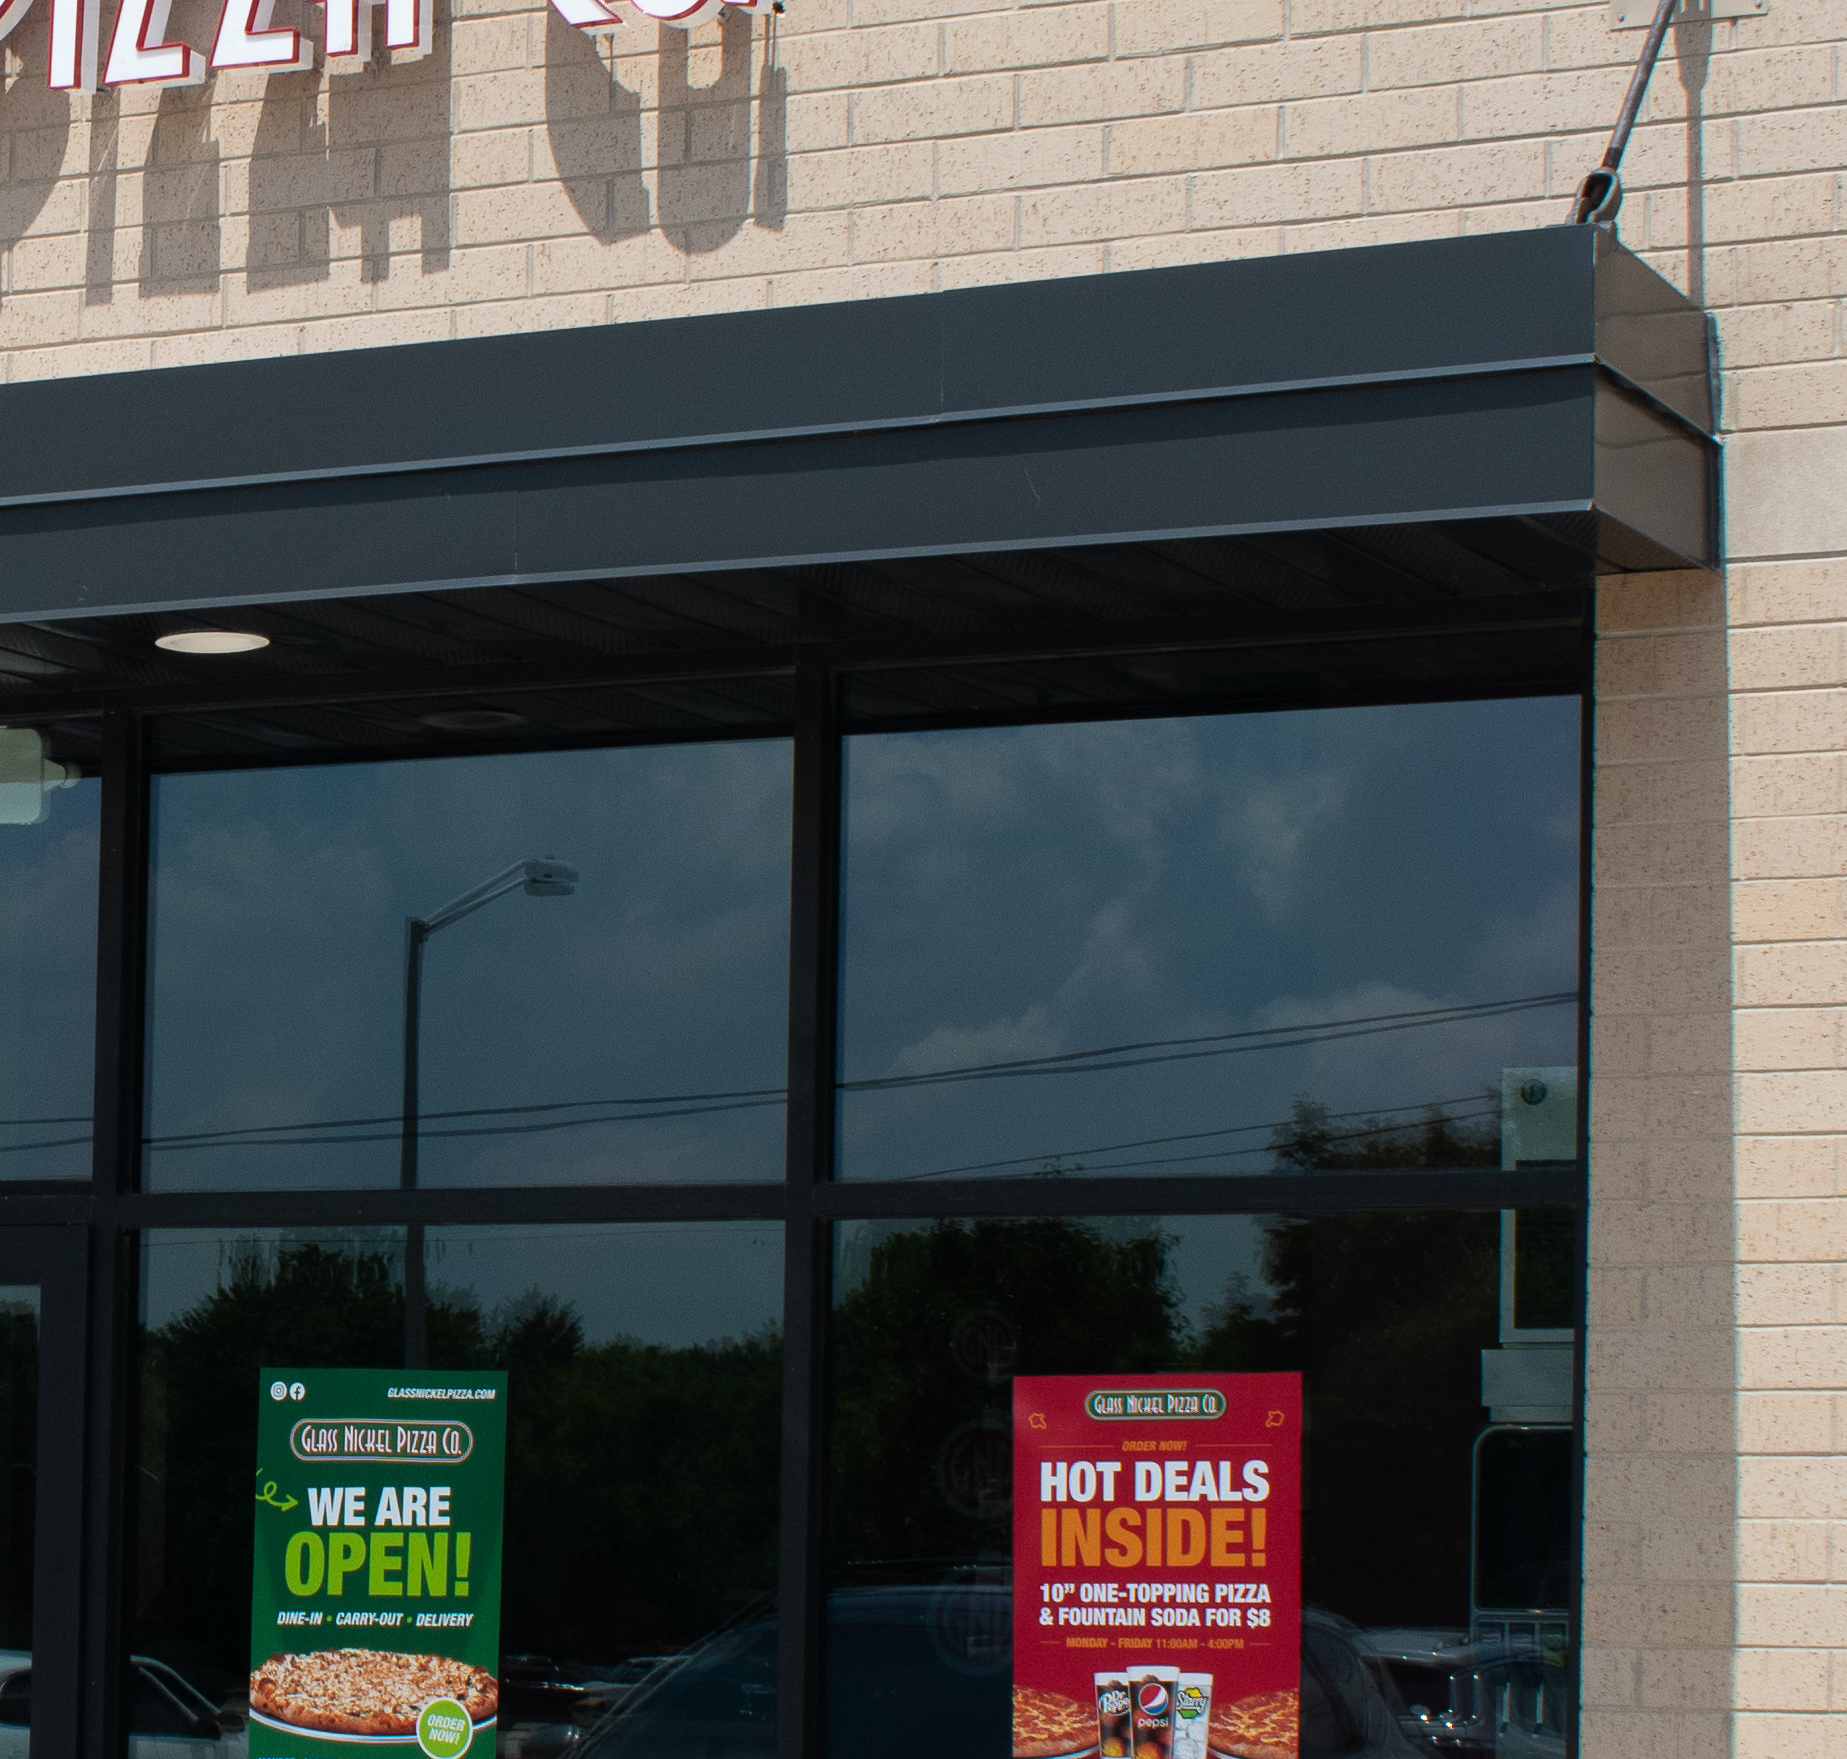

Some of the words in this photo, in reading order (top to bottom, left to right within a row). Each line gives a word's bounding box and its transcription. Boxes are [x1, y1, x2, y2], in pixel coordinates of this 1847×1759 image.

[387, 1387, 496, 1400] GLASSNICKELPIZZA.COM
[1094, 1394, 1123, 1414] GLASS
[1126, 1394, 1165, 1414] NICKEL
[1167, 1393, 1200, 1414] PIZZA
[301, 1425, 338, 1453] GLASS
[344, 1425, 393, 1453] NICKEL
[396, 1426, 437, 1455] PIZZA
[442, 1427, 462, 1455] CO.
[1122, 1440, 1157, 1452] ORDER
[1159, 1440, 1188, 1452] NOW!
[1040, 1460, 1122, 1503] HOT
[1134, 1459, 1271, 1503] DEALS
[307, 1486, 366, 1527] WE
[374, 1486, 452, 1527] ARE
[1040, 1506, 1267, 1568] INSIDE!
[285, 1531, 472, 1597] OPEN!
[1079, 1582, 1210, 1604] ONE-TOPPING
[1214, 1583, 1272, 1604] PIZZA
[276, 1611, 324, 1626] DINE-IN
[335, 1612, 404, 1626] CARRY-OUT
[415, 1613, 474, 1627] DELIVERY
[1038, 1606, 1054, 1626] &
[1058, 1607, 1146, 1627] FOUNTAIN
[1150, 1607, 1202, 1628] SODA
[1205, 1607, 1242, 1628] FOR
[1246, 1607, 1272, 1629] $8
[1065, 1637, 1108, 1649] MONDAY
[1117, 1638, 1153, 1649] FRIDAY
[1156, 1638, 1199, 1650] 11:00AM
[1207, 1639, 1246, 1650] 4:00PM
[427, 1713, 466, 1732] ORDER
[1137, 1717, 1169, 1729] pepsi
[428, 1727, 461, 1745] NOW!
